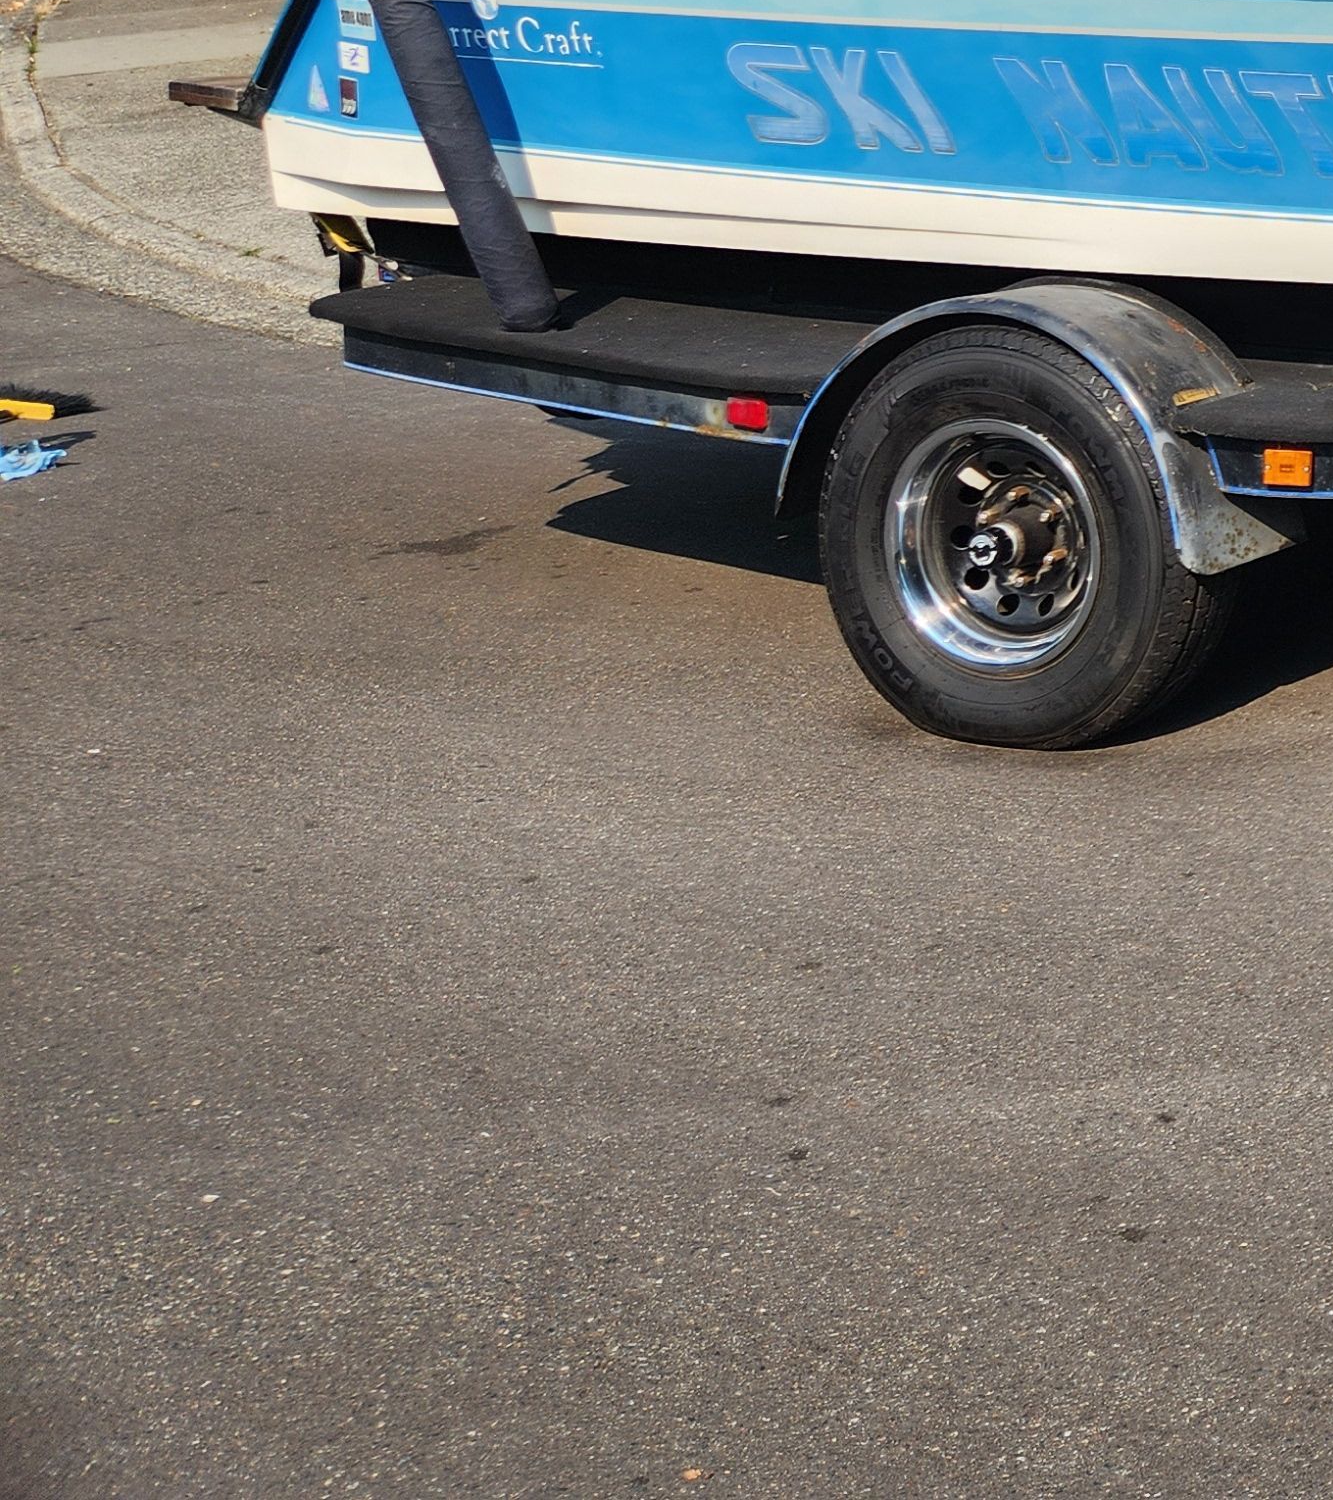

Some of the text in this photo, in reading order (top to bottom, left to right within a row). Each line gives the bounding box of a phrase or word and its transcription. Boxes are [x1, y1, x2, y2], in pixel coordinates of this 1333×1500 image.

[449, 16, 594, 55] rrect Craft
[727, 42, 957, 155] SKI
